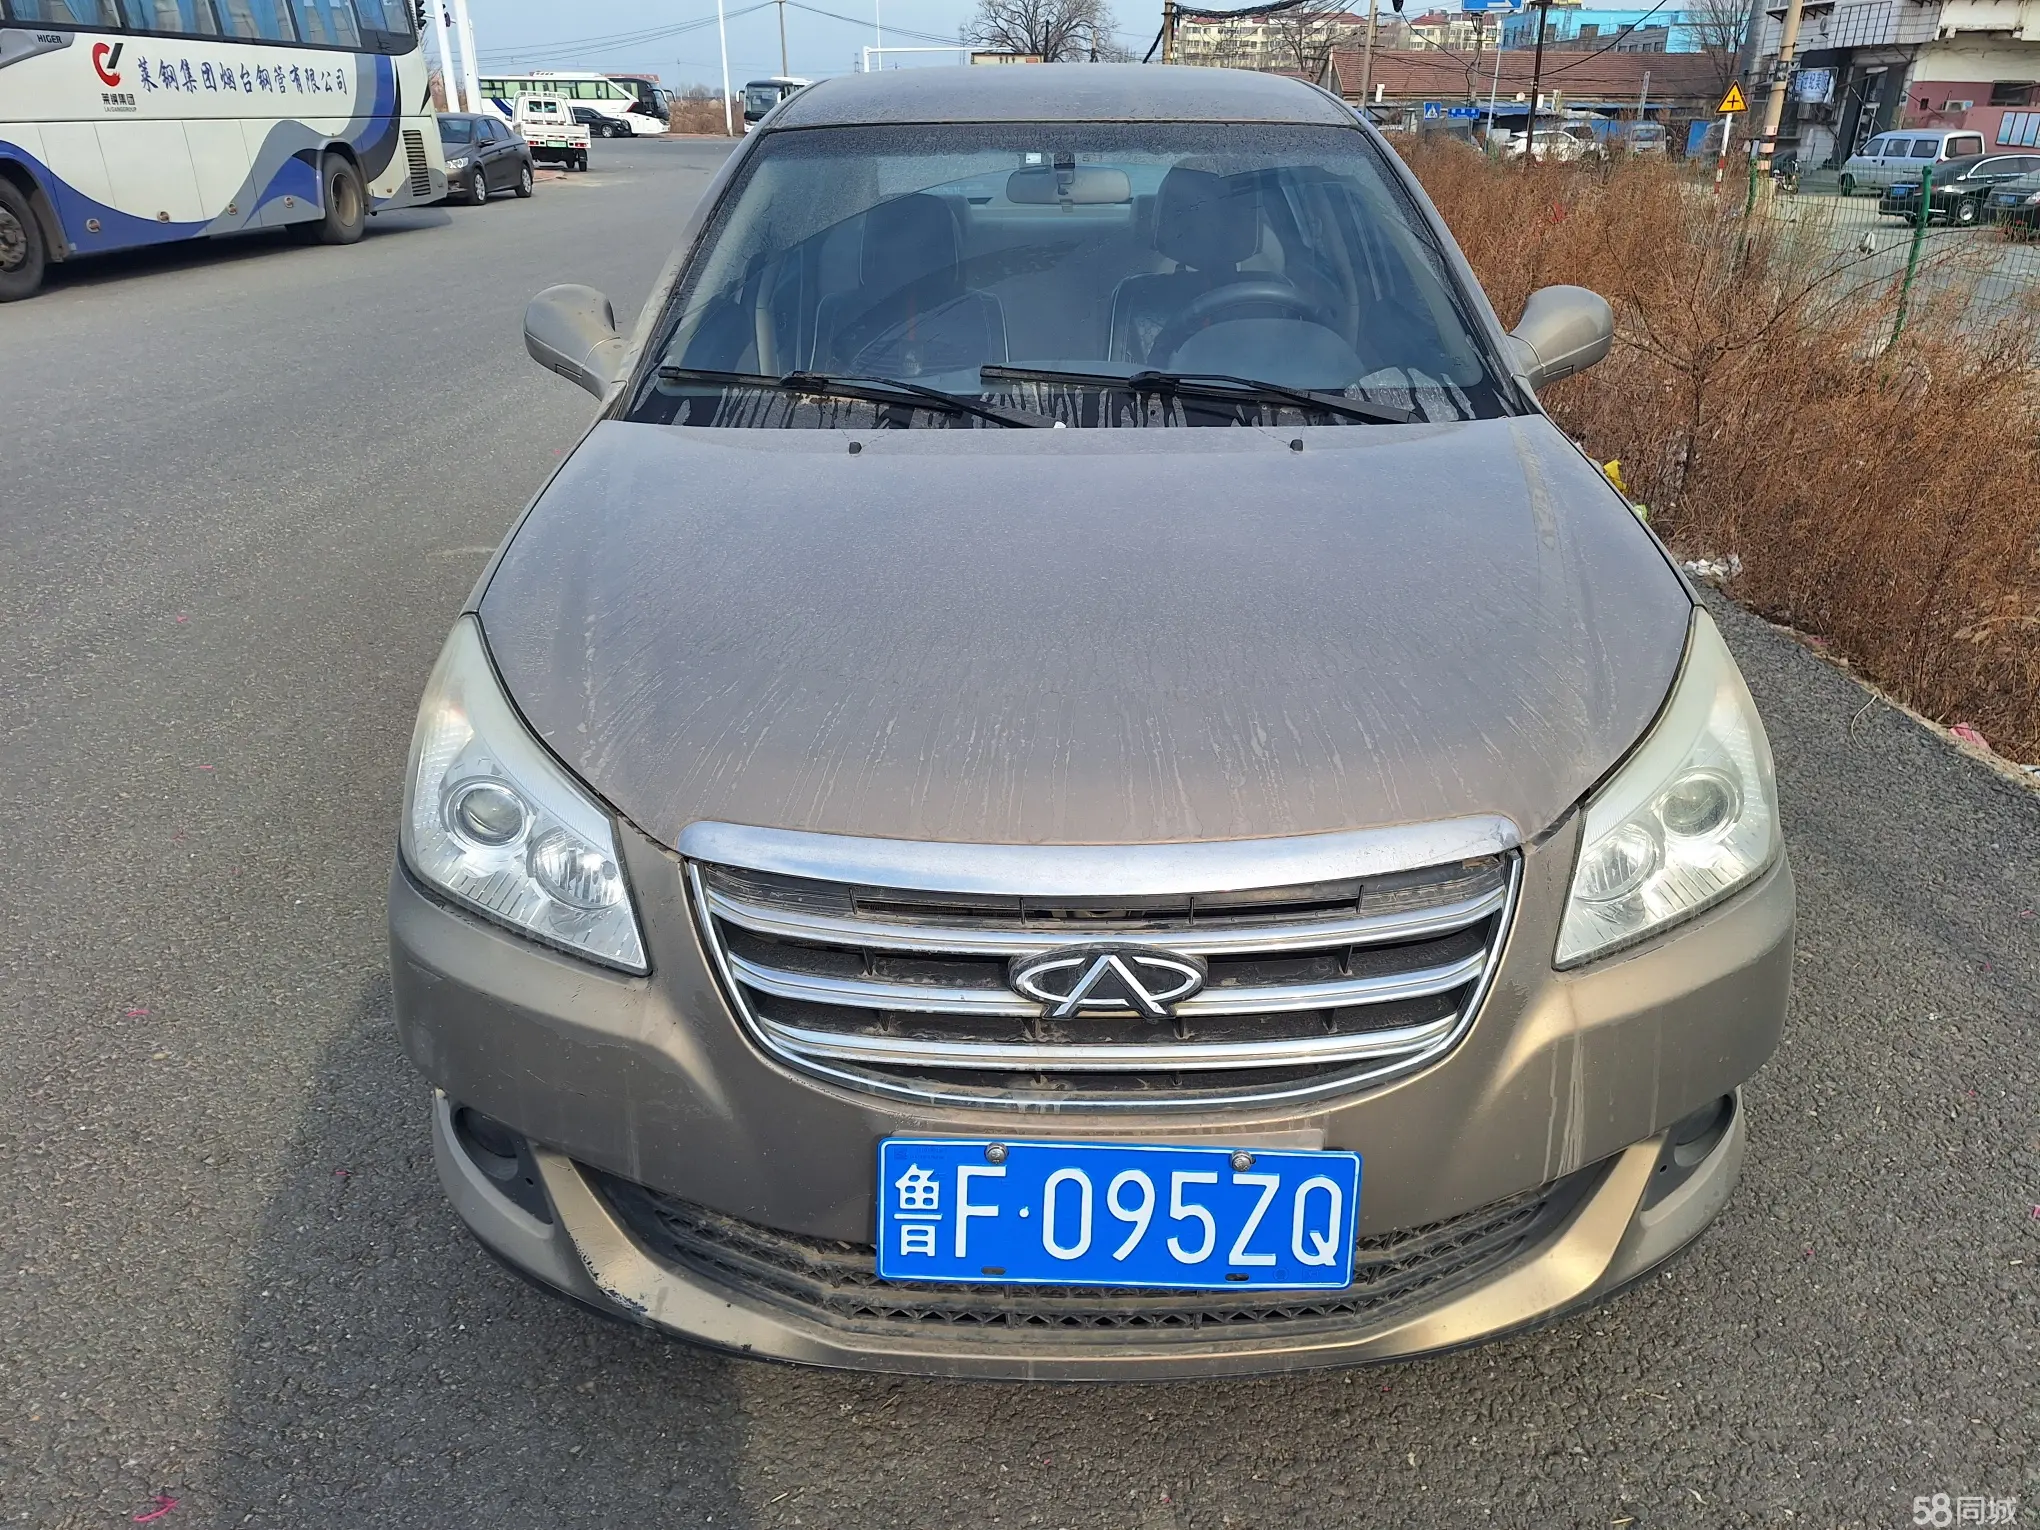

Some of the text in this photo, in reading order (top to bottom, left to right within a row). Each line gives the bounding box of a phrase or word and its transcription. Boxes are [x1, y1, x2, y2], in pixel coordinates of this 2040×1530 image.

[36, 34, 62, 44] HIGER
[137, 56, 348, 95] 莱钢集团烟台钢管有限公司
